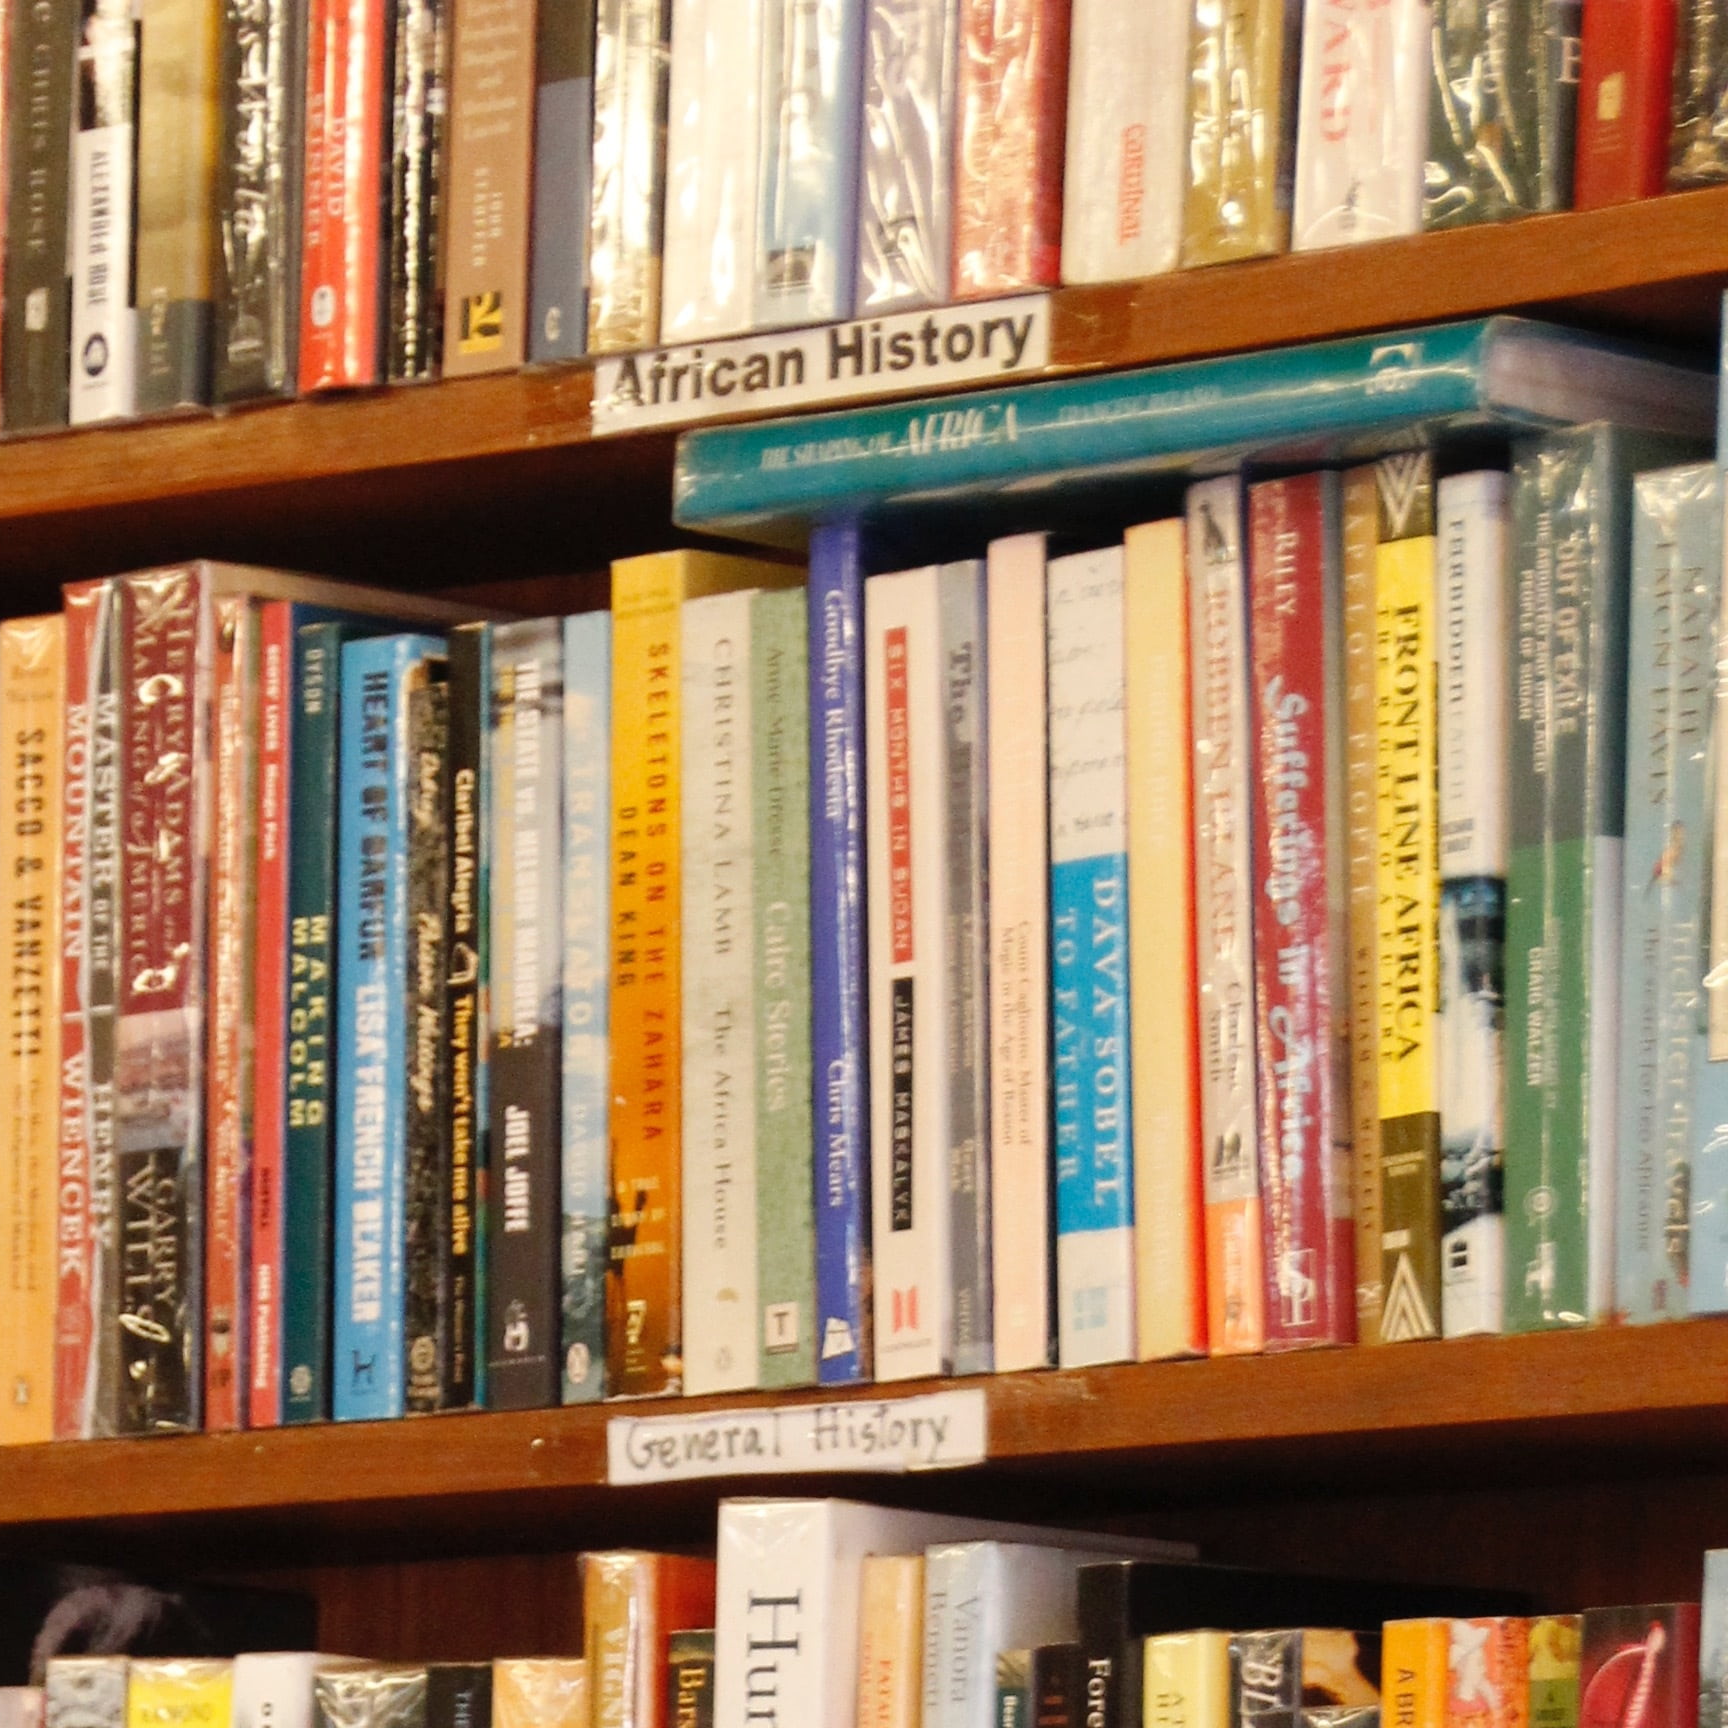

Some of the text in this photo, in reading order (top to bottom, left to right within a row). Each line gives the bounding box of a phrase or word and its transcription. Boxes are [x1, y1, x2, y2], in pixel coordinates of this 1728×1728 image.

[614, 312, 1035, 407] African History
[10, 728, 45, 1060] SACCO & VANZETTI
[643, 641, 672, 1144] SKELETONS ON THE ZAHARA
[1390, 604, 1425, 1064] FRONT LINE AFRICA
[288, 915, 308, 1130] MALCOLM
[307, 914, 329, 1128] MAKING
[1090, 876, 1123, 1208] DAVA SOBEL
[625, 1403, 951, 1470] General History
